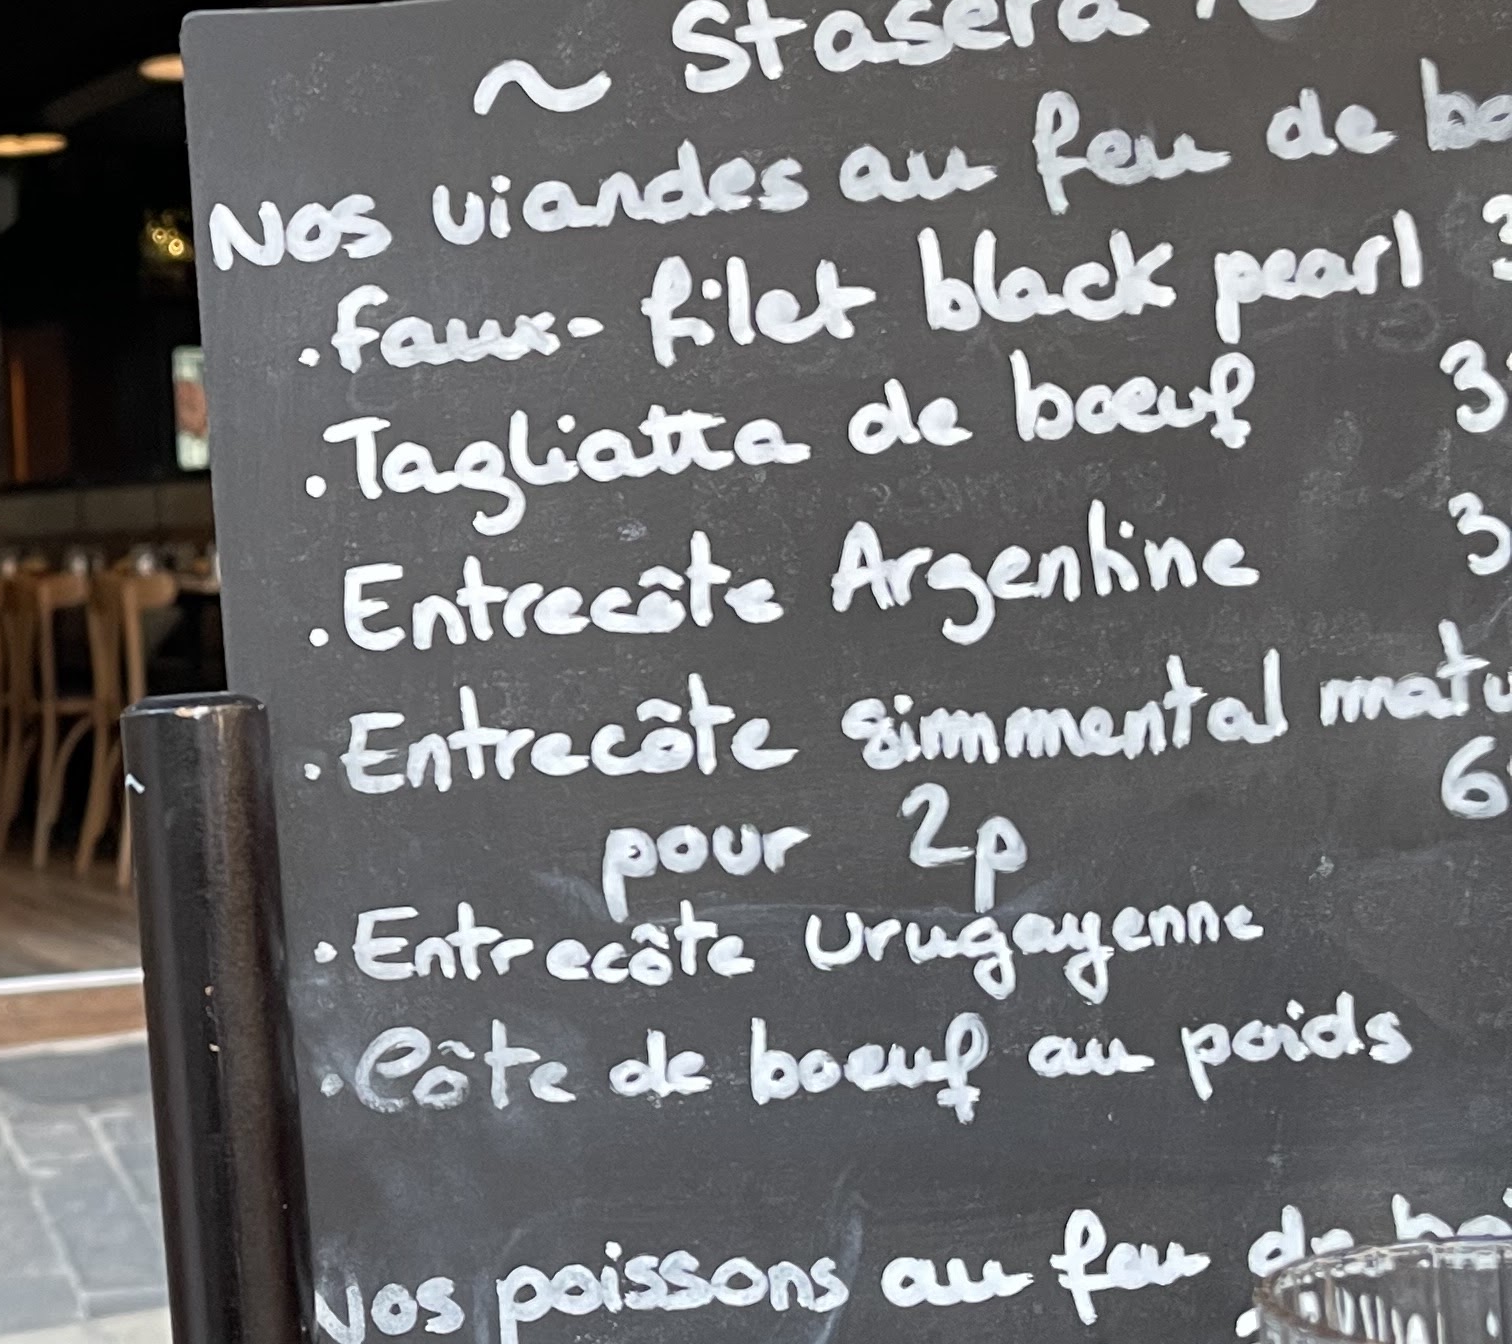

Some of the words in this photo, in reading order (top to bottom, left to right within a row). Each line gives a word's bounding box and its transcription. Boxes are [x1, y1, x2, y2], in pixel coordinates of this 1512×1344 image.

[208, 191, 393, 272] Nos
[431, 140, 809, 246] viandes
[839, 143, 999, 203] au
[1031, 90, 1232, 216] feu
[1266, 88, 1398, 160] de
[640, 255, 878, 369] filet
[917, 226, 1178, 332] black
[1214, 208, 1424, 345] pearl
[848, 378, 974, 455] de
[1439, 339, 1512, 434] 3
[343, 530, 786, 652] Entrecôte
[830, 498, 1261, 646] Argentine
[339, 672, 800, 794] Entrecôte
[602, 823, 813, 924] pour
[900, 782, 1028, 914] 2p
[1441, 735, 1512, 819] 6
[352, 900, 756, 986] Entrecôte
[354, 1018, 578, 1114] Côte
[609, 1028, 713, 1098] de
[1028, 1035, 1155, 1078] au
[1181, 990, 1414, 1102] poids
[879, 1256, 1036, 1309] au
[1049, 1208, 1213, 1326] feu
